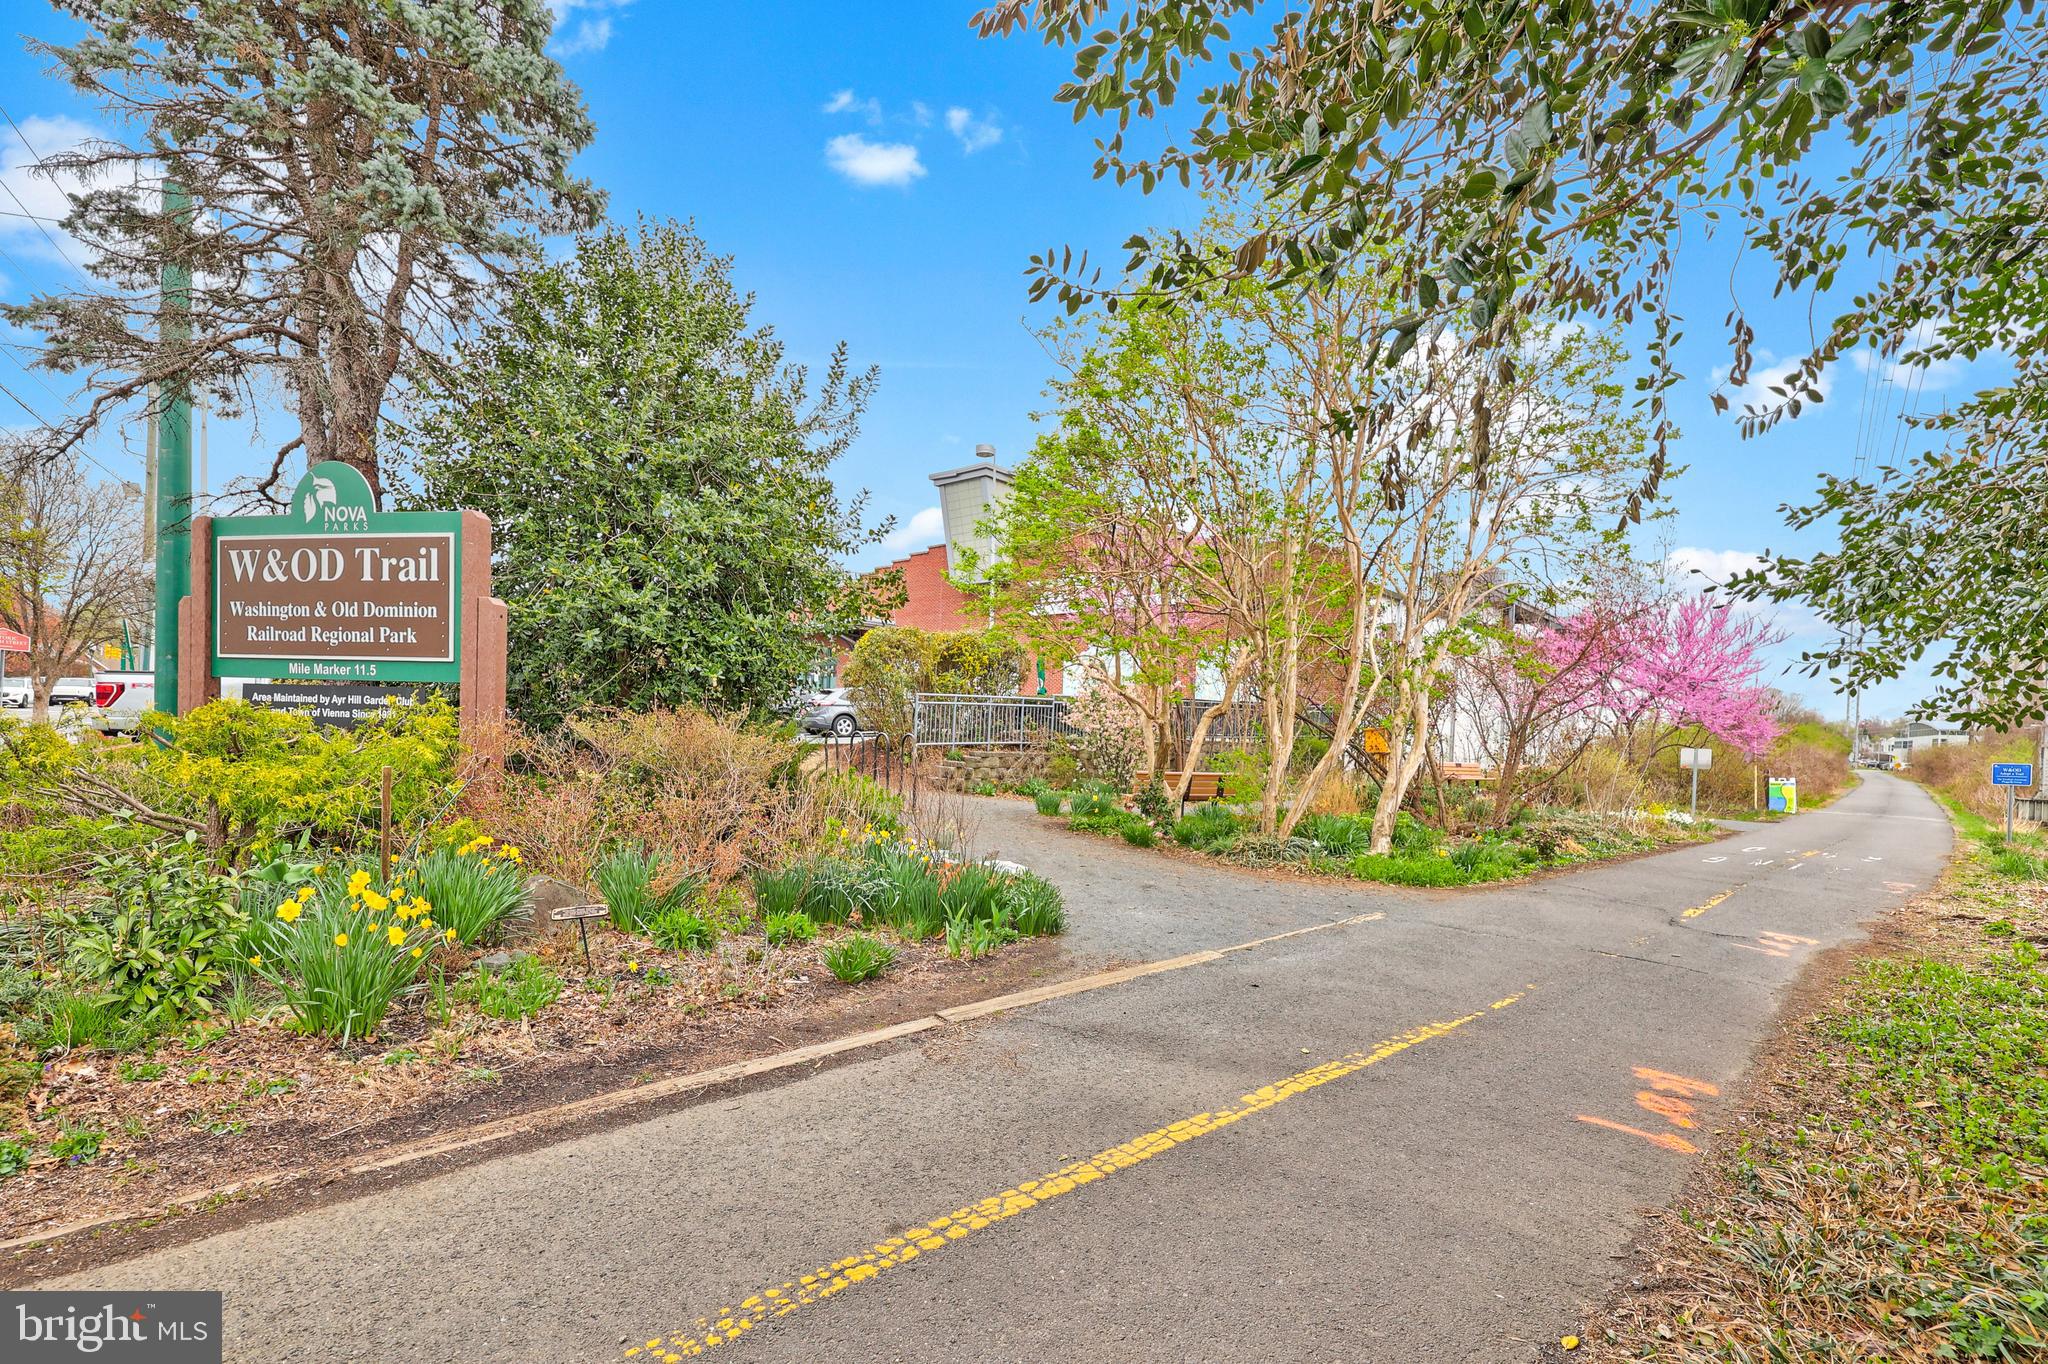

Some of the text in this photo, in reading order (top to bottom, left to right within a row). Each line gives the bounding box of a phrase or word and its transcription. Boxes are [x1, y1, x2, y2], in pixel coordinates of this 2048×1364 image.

[324, 505, 368, 522] NOVA
[324, 522, 369, 532] PARKS
[228, 547, 440, 582] W&OD Trail
[229, 600, 438, 621] Washington & Old Dominion
[247, 625, 418, 647] Railroad Regional Park
[288, 662, 377, 676] Mile Marker 11.5
[252, 692, 272, 702] Area
[273, 692, 318, 704] Maintained
[319, 694, 330, 706] by
[331, 695, 346, 706] Ayr
[347, 694, 362, 705] Hill
[363, 695, 393, 706] Garde
[311, 707, 321, 718] of
[321, 708, 351, 719] Vienna
